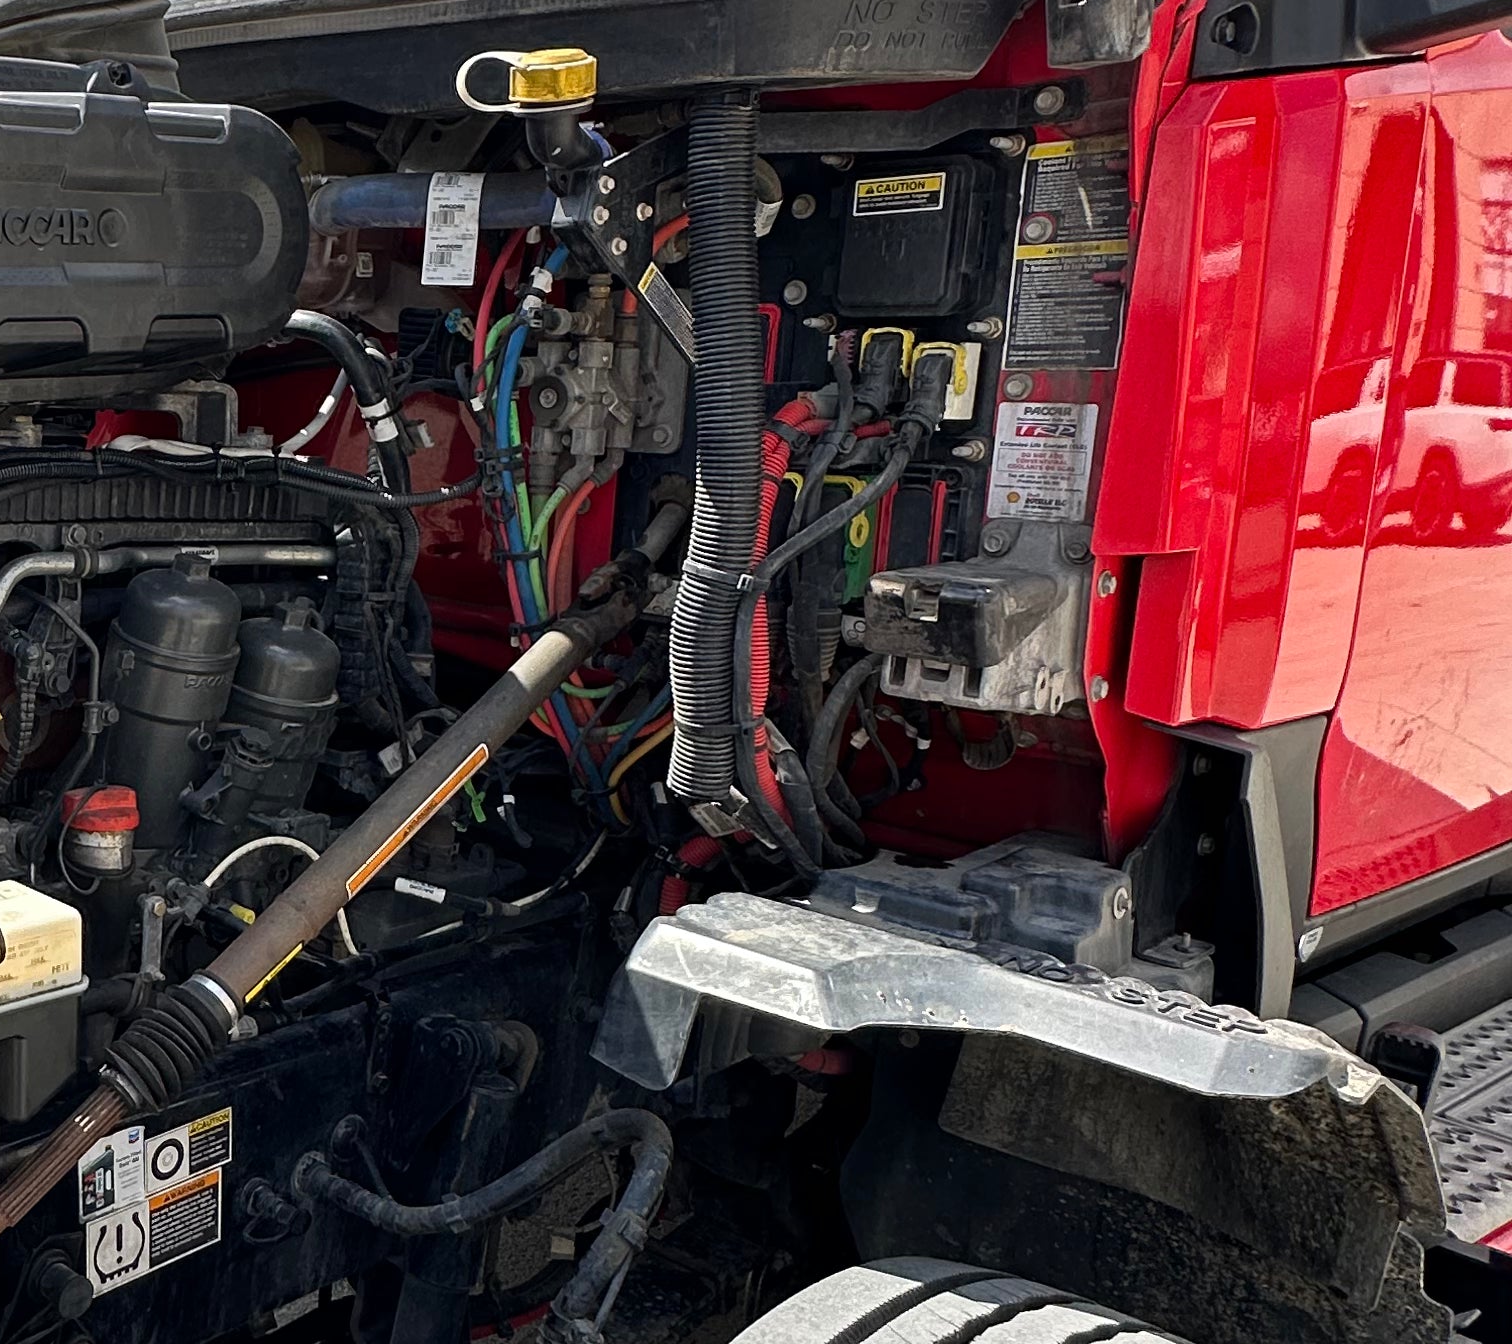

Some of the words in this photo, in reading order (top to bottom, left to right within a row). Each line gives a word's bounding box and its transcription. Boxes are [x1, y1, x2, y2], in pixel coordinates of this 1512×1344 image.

[884, 31, 926, 49] NOT
[876, 181, 926, 194] CAUTION
[995, 956, 1074, 982] NO
[1112, 988, 1268, 1034] STEP
[195, 1112, 230, 1131] CAUTION
